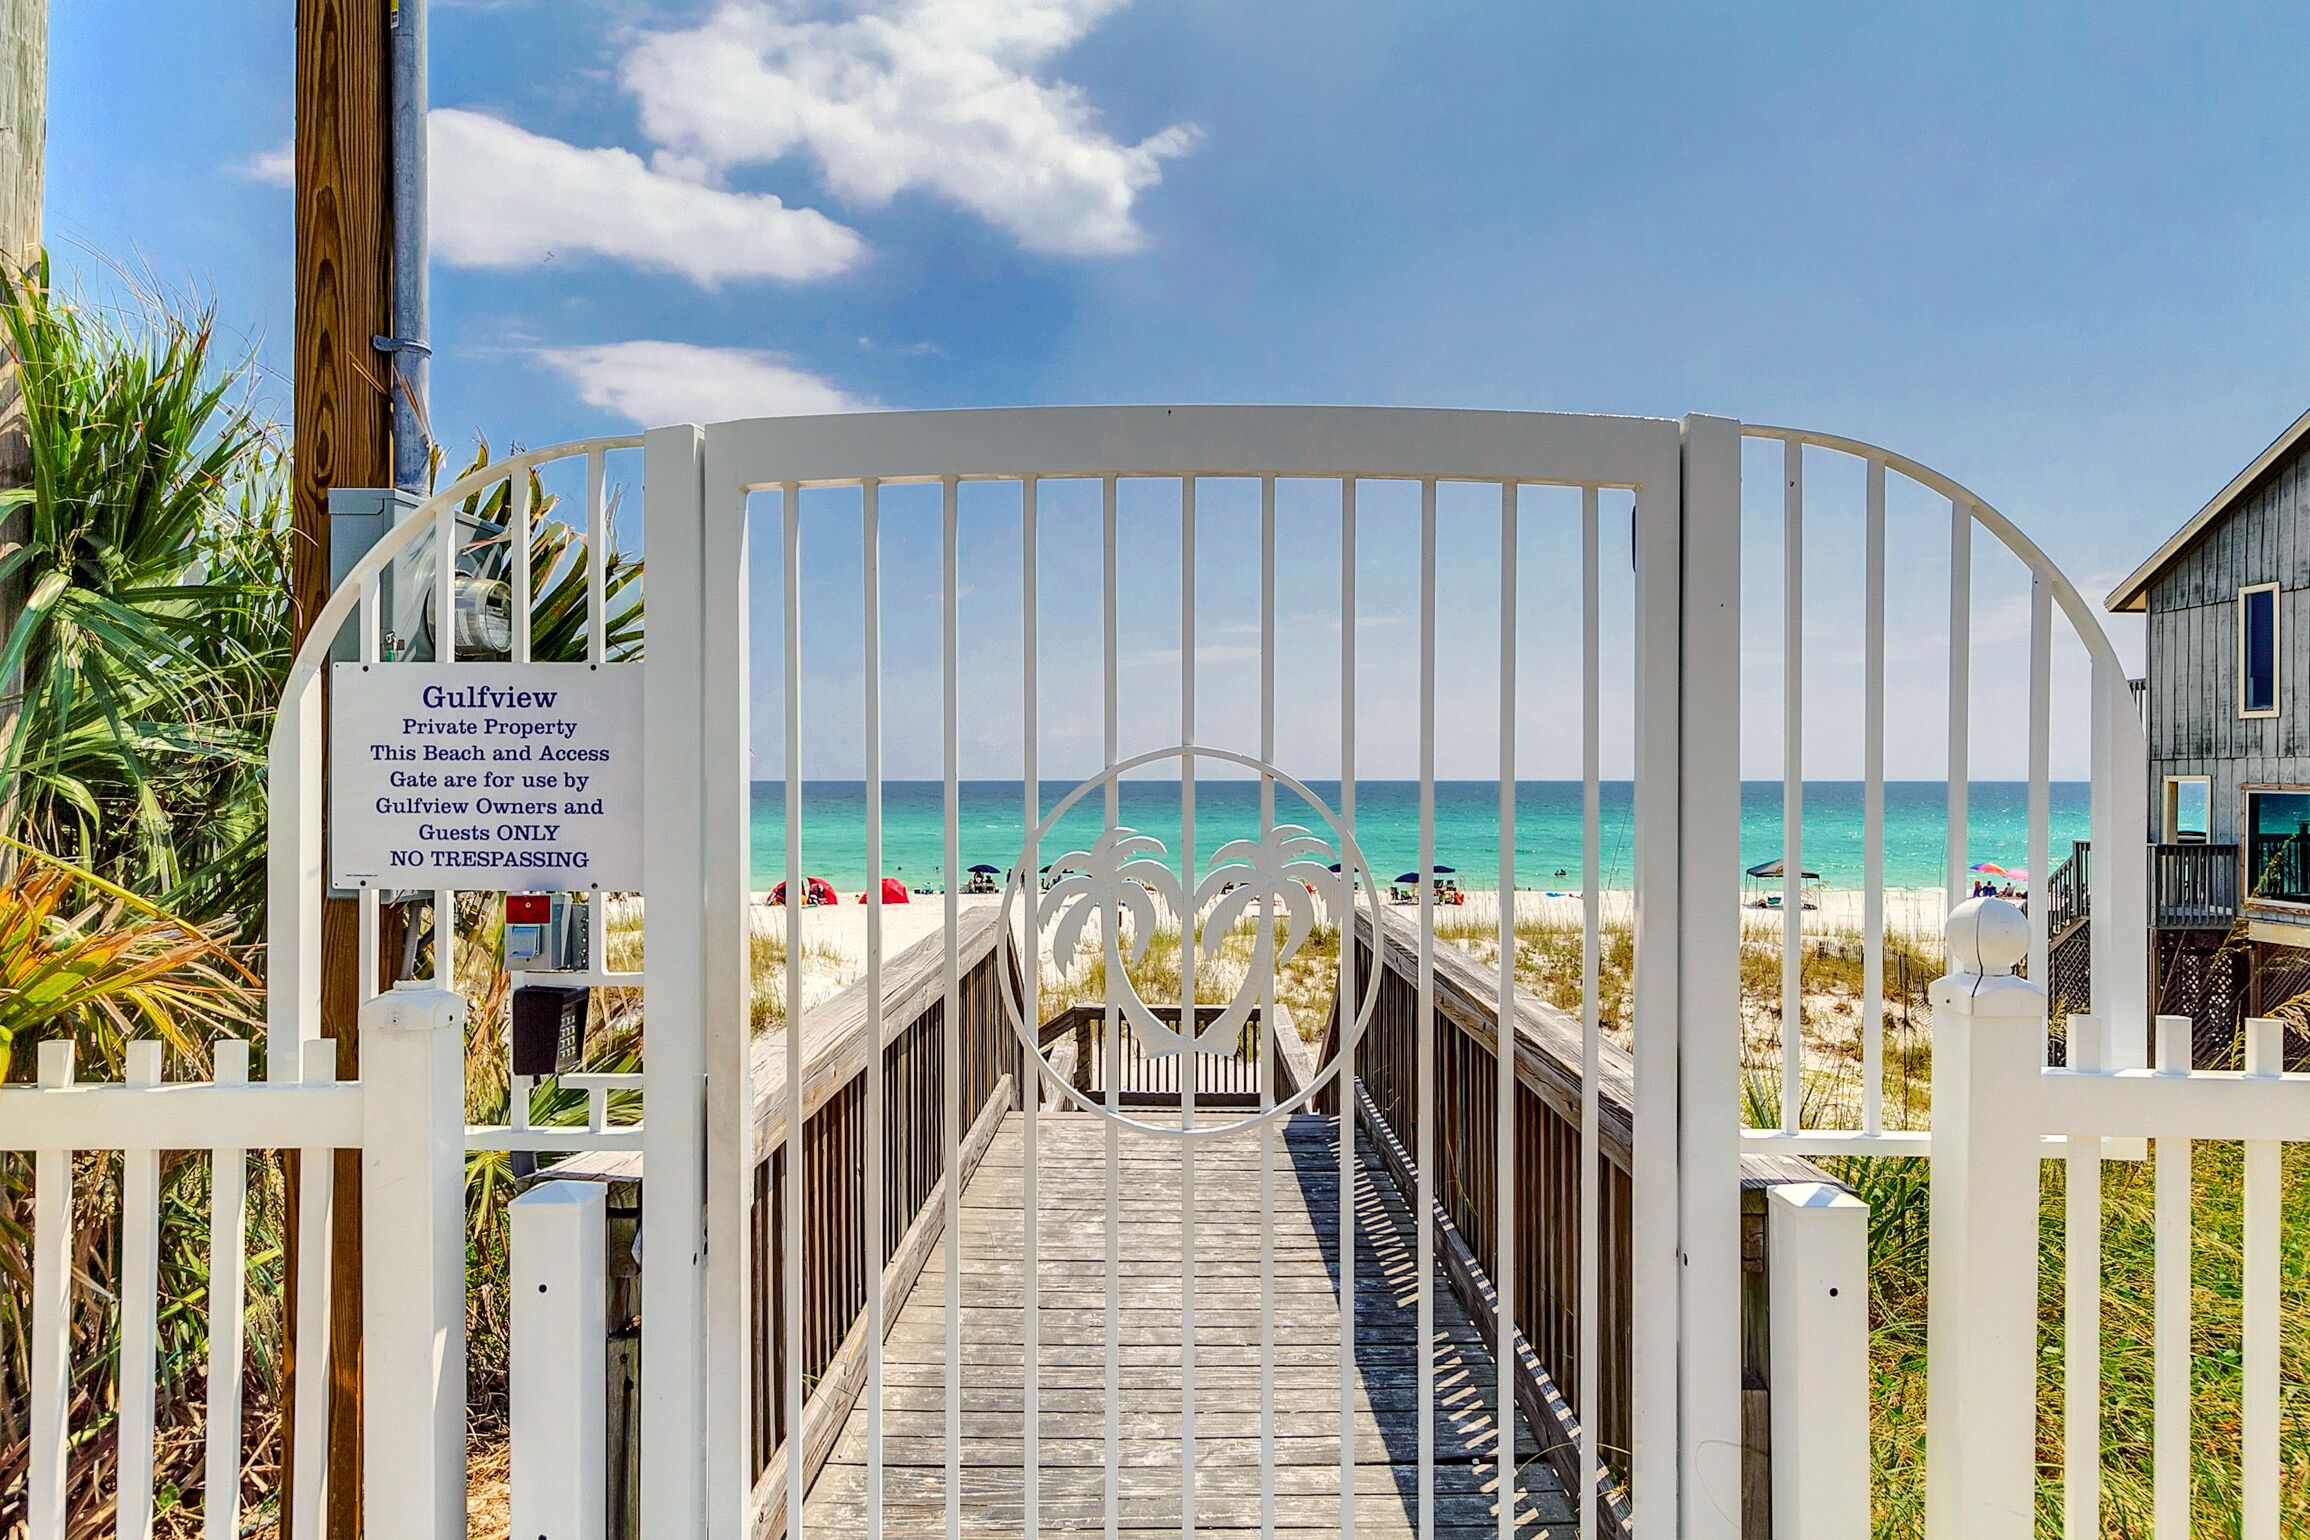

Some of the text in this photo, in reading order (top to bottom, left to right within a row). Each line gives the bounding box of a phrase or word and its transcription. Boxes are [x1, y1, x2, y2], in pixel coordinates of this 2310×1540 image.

[423, 686, 557, 708] Gulfview
[403, 719, 577, 739] Private Property
[371, 745, 609, 761] This Beach and Access
[391, 771, 589, 792] Gate are for use by
[376, 798, 604, 814] Gulfview Owners and
[419, 824, 560, 841] Guests ONLY
[390, 851, 589, 868] NO TRESPASSING
